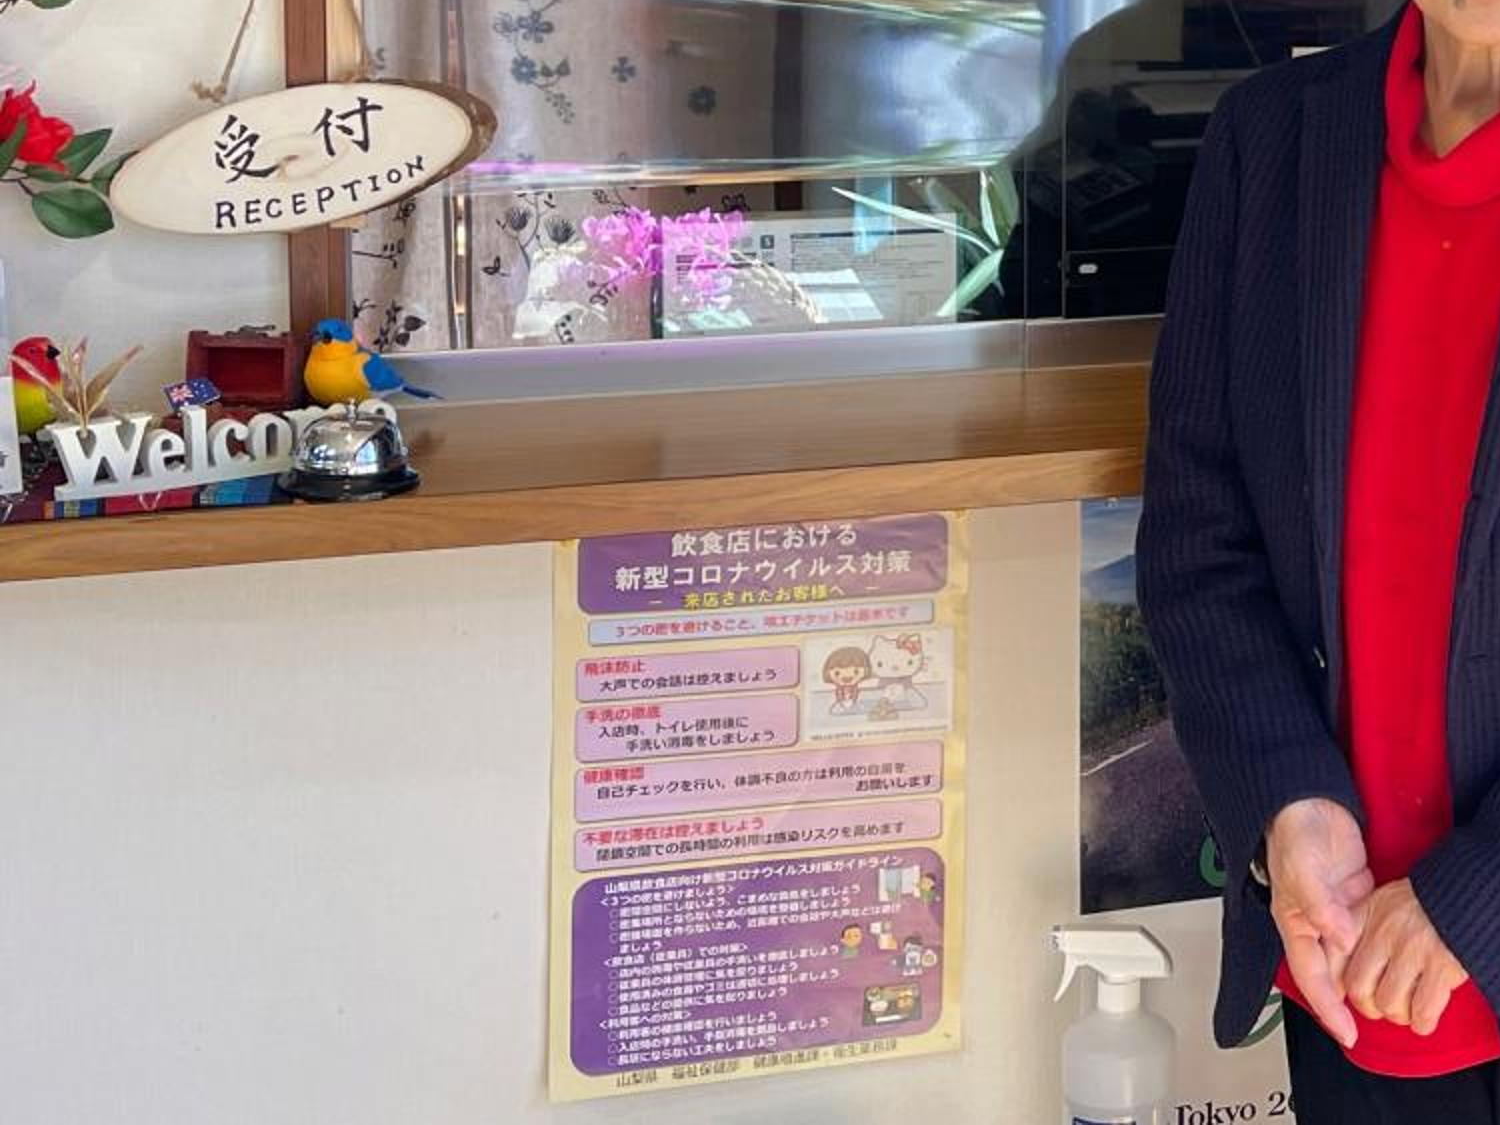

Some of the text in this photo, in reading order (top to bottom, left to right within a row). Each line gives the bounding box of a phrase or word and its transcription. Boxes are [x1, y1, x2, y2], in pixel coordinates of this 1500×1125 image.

[213, 96, 384, 184] 受付
[214, 155, 426, 229] RECEPTION
[50, 398, 398, 488] Welco
[671, 522, 857, 558] 飲食店における
[615, 550, 912, 591] 新型コロナウイルス対策
[599, 668, 778, 692] 大声での会話は控えましょう
